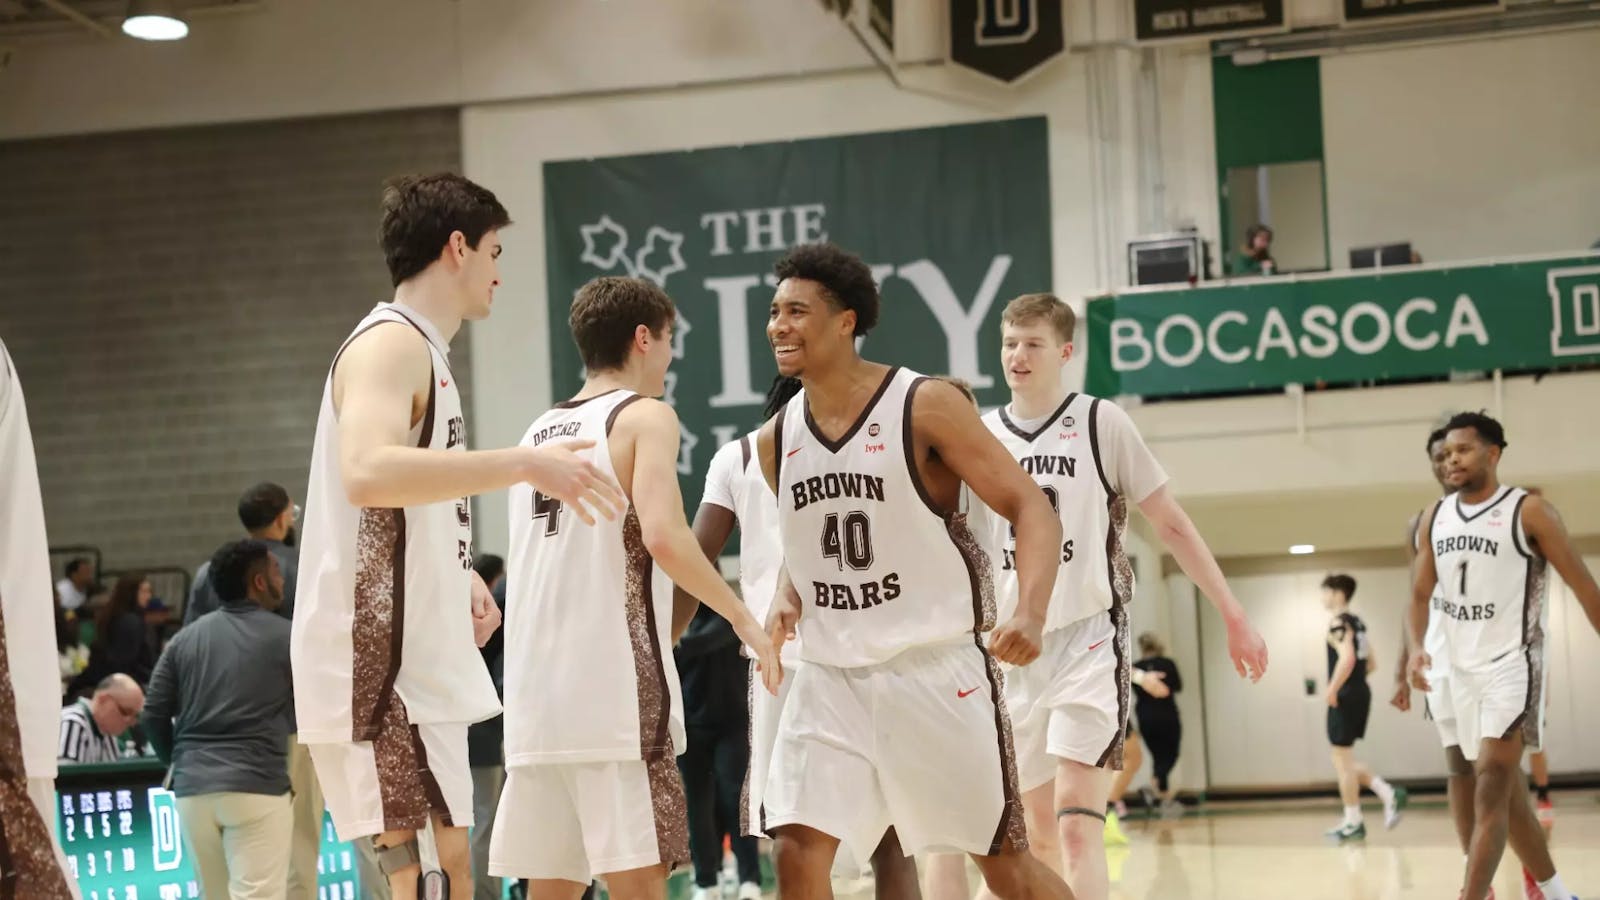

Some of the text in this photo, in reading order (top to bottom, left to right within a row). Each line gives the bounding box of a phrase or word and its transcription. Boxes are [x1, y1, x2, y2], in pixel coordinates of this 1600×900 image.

[701, 203, 829, 257] THE
[703, 255, 1013, 408] IY
[1109, 294, 1490, 372] BOCASOCA
[865, 444, 877, 454] Ivy
[1019, 455, 1077, 478] OWN
[531, 486, 564, 538] 4
[791, 472, 885, 511] BROWN
[820, 510, 874, 571] 40
[1437, 535, 1498, 557] BROWN
[812, 572, 901, 611] BEARS
[1458, 560, 1469, 596] 1
[147, 786, 182, 872] D
